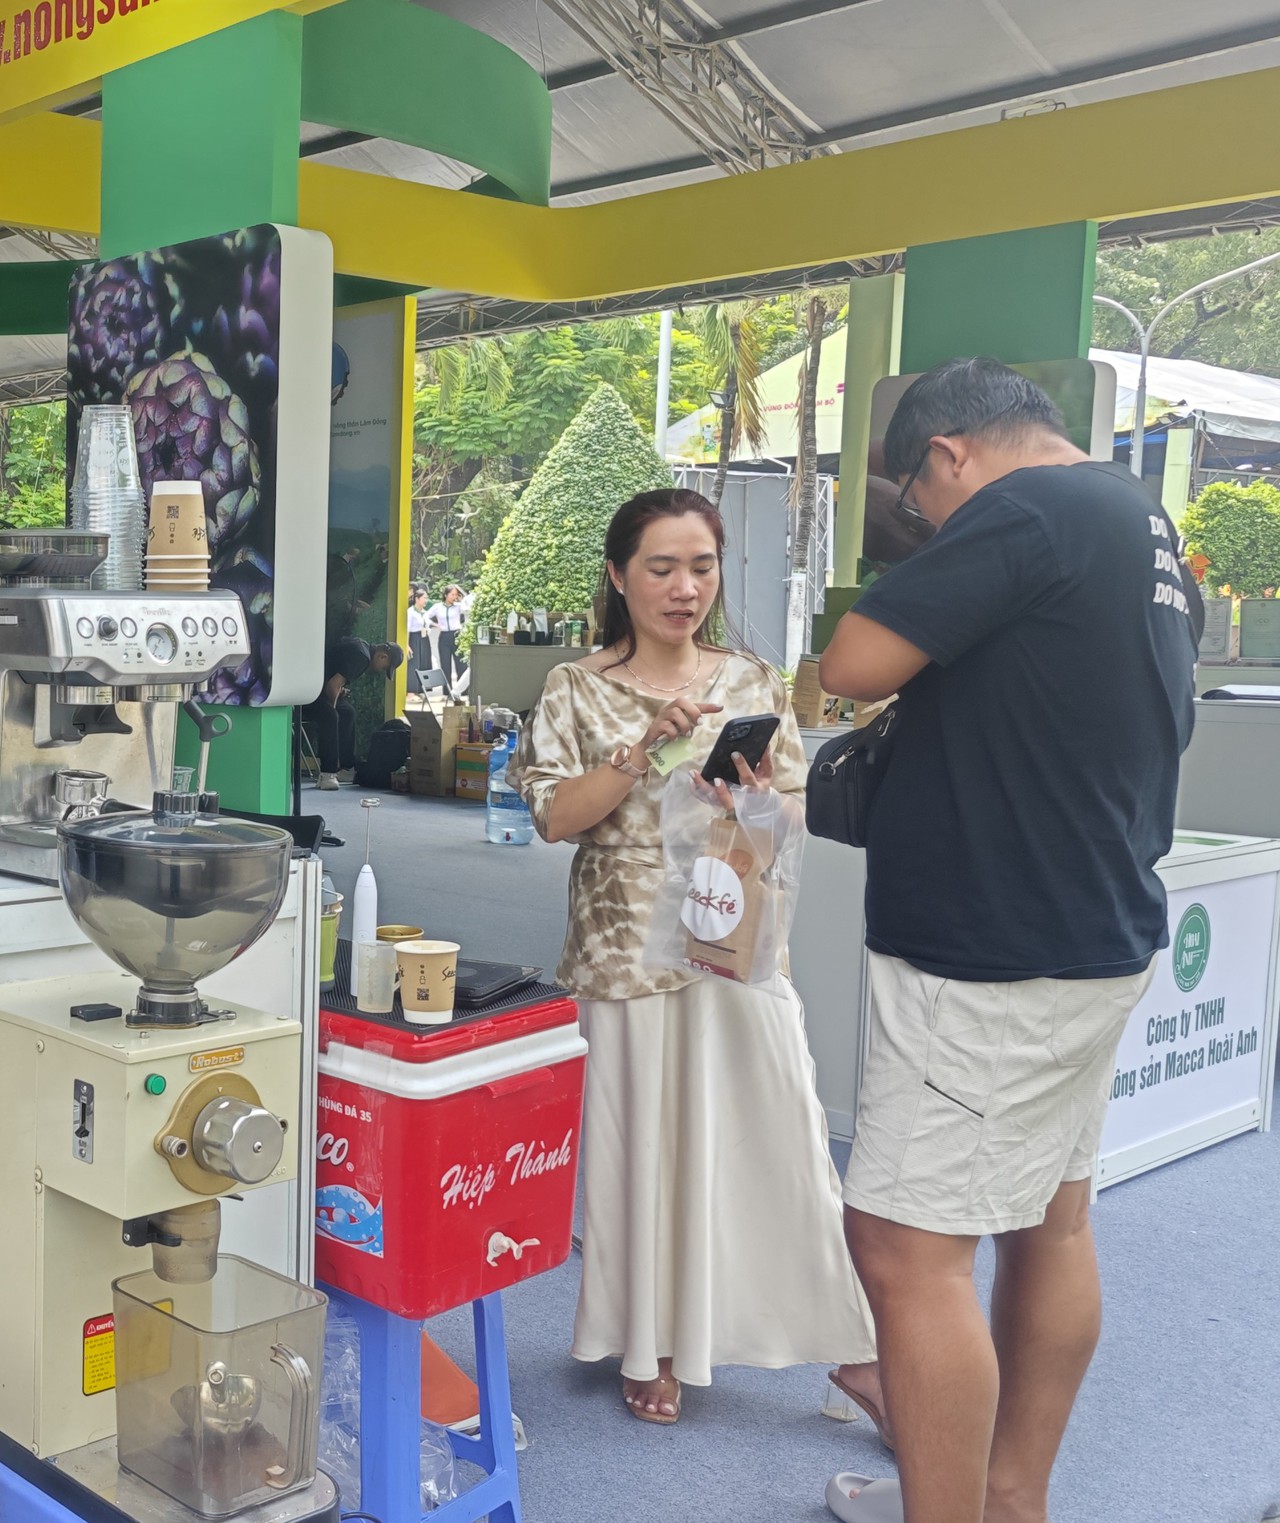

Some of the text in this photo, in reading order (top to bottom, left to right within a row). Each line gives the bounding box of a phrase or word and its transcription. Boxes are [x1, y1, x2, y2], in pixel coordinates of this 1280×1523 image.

[1146, 997, 1225, 1046] Công ty TNHH
[1139, 1054, 1161, 1090] sản
[1164, 1047, 1205, 1081] Macca
[1207, 1032, 1233, 1066] Hoài
[1235, 1026, 1257, 1057] Anh
[318, 1096, 372, 1122] HÙNG ĐÁ 35
[440, 1128, 573, 1210] Hiệp Thành
